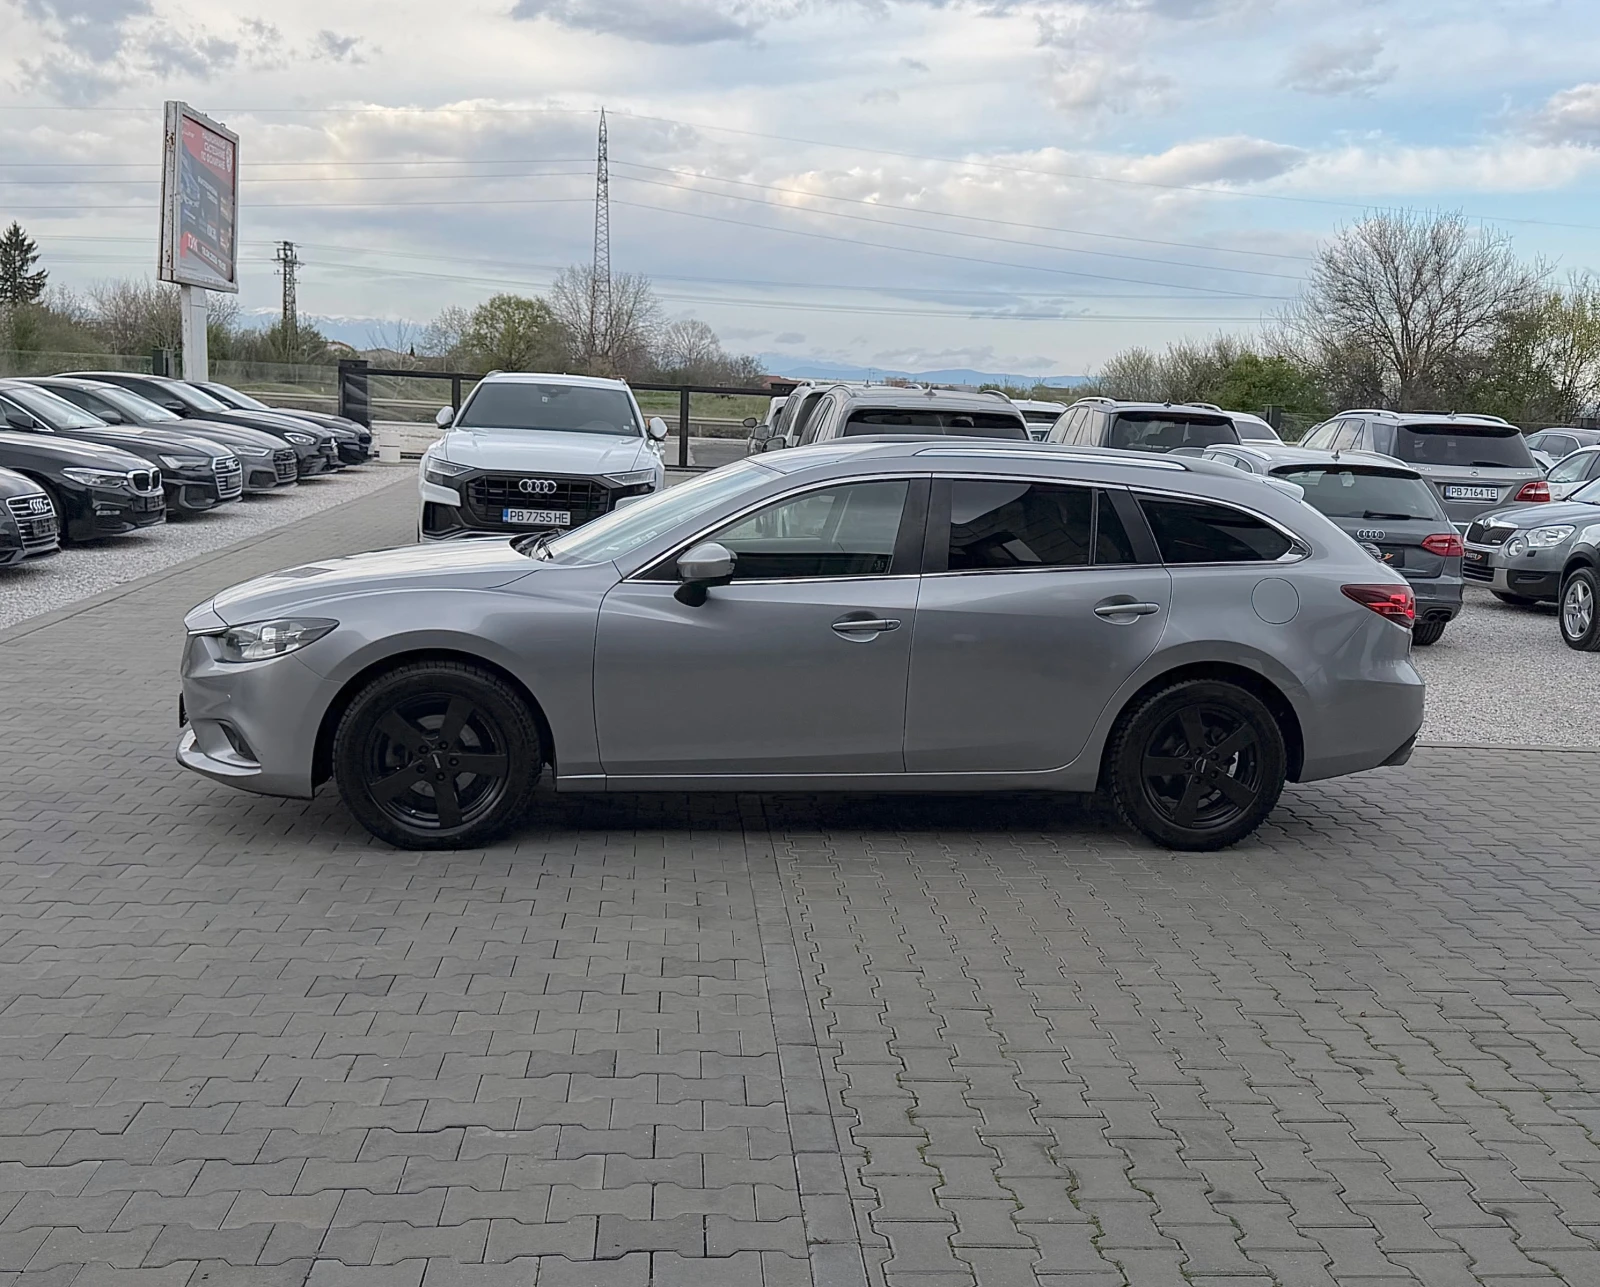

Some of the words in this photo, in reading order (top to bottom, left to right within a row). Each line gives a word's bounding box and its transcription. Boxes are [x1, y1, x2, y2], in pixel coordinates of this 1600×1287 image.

[1451, 487, 1462, 496] PB
[1463, 488, 1484, 497] 7164
[1485, 489, 1496, 498] TE
[510, 510, 524, 522] PB
[526, 511, 552, 523] 7755
[553, 512, 569, 524] HE
